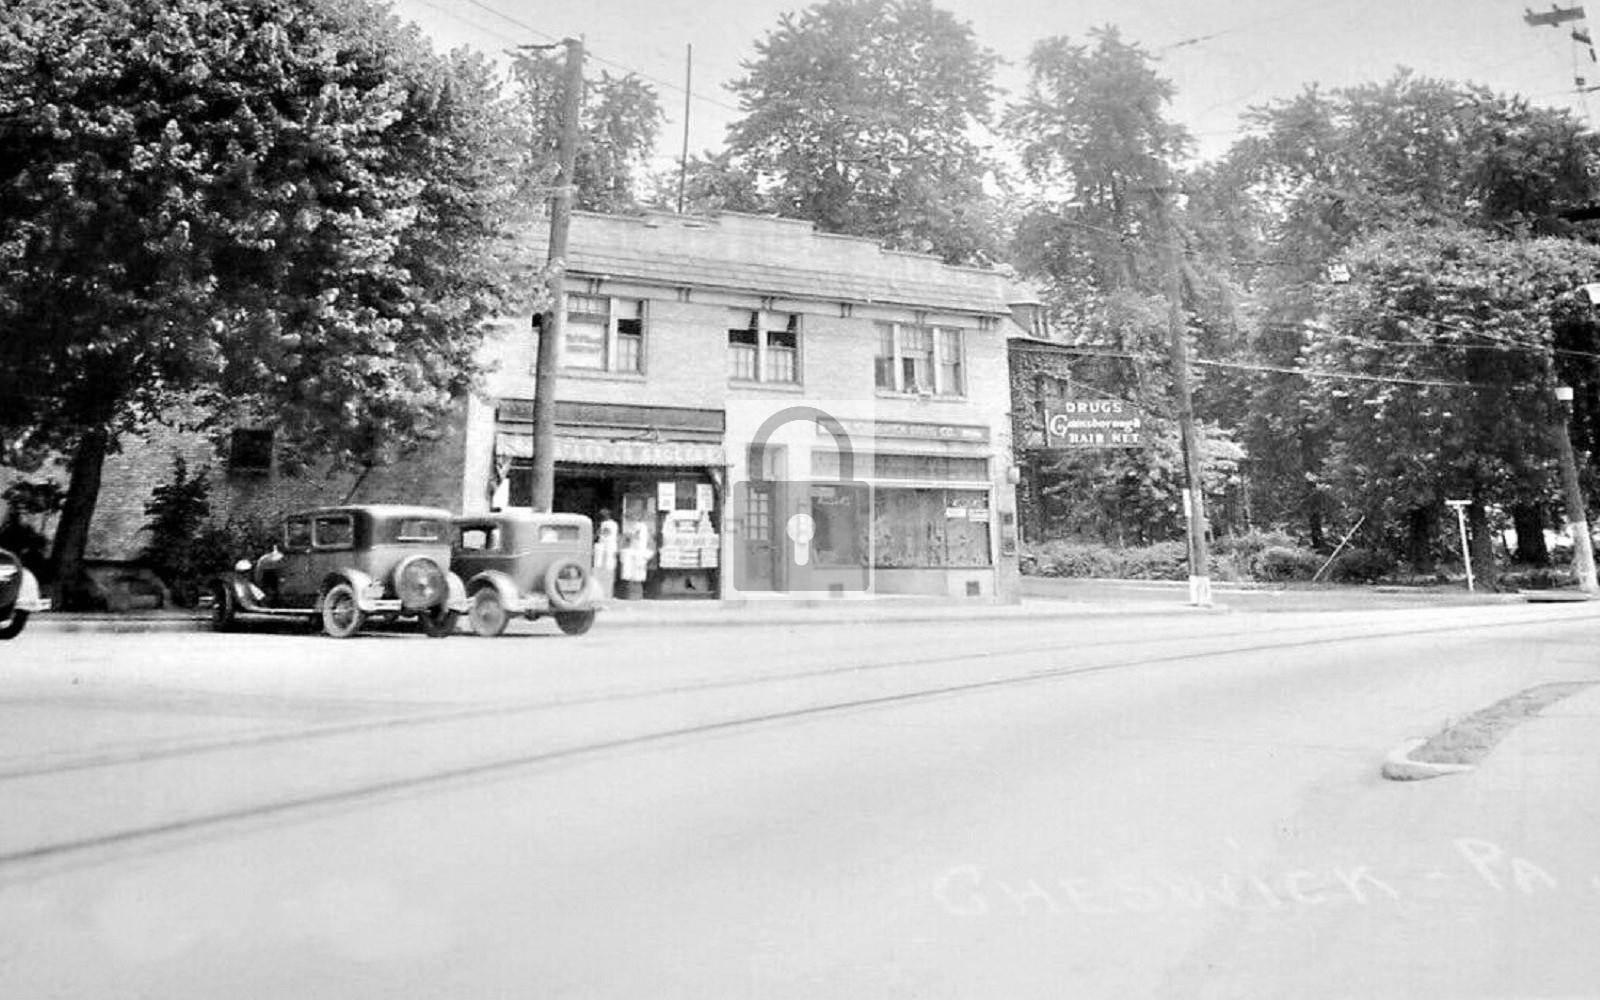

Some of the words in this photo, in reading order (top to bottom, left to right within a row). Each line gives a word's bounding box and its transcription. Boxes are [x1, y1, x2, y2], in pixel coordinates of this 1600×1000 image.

[1065, 402, 1122, 413] DRUGS
[1069, 433, 1104, 443] HAIR
[1111, 433, 1139, 443] NET
